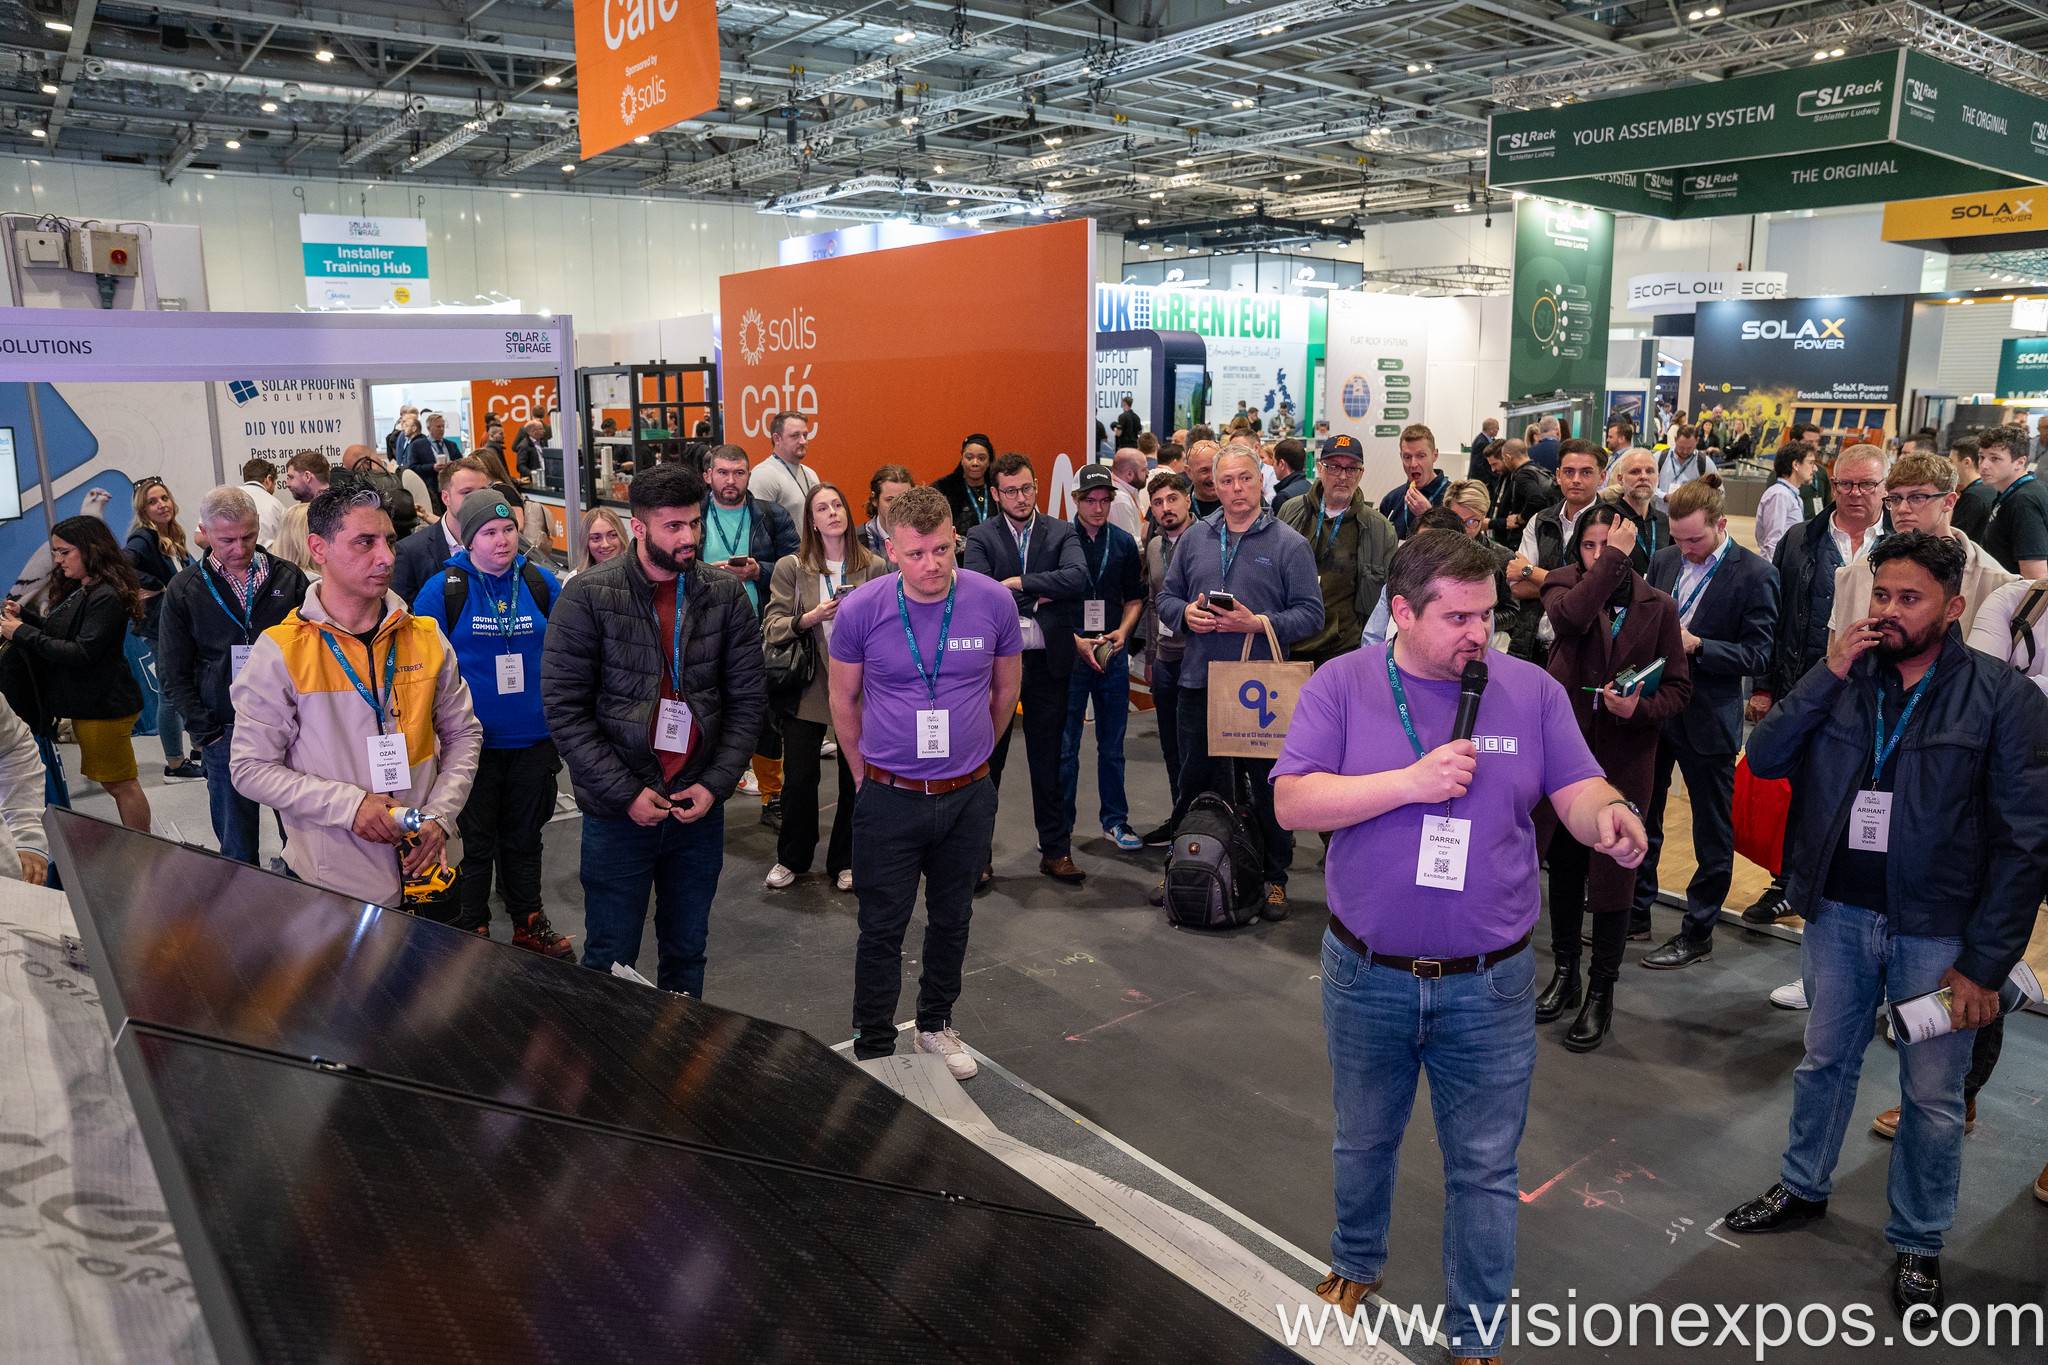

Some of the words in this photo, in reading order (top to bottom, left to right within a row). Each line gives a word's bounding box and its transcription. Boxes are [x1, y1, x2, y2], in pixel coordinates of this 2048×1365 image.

[638, 75, 666, 111] solis
[1816, 86, 1844, 108] SL
[1844, 79, 1884, 98] Rack
[1912, 80, 1924, 102] SL
[1923, 84, 1938, 100] Rack
[1813, 111, 1849, 123] Schletter
[1850, 106, 1880, 118] Ludwig
[1962, 105, 1976, 126] THE
[1976, 111, 2008, 136] ORGINIAL
[1572, 127, 1615, 146] YOUR
[1618, 113, 1703, 141] ASSEMBLY
[1705, 103, 1776, 130] SYSTEM
[1510, 132, 1530, 149] SL
[1529, 128, 1556, 142] Rack
[1509, 152, 1534, 162] Schletter
[1534, 150, 1555, 160] Ludwig
[1791, 168, 1820, 185] THE
[1823, 160, 1899, 182] ORGINIAL
[1608, 173, 1637, 188] SYSTEM
[1650, 174, 1661, 188] SL
[1660, 176, 1674, 187] Rack
[1695, 175, 1714, 189] SL
[1713, 172, 1738, 184] Rack
[1717, 190, 1737, 199] Ludwig
[1951, 198, 2033, 220] SOLAX
[1992, 214, 2032, 224] POWER
[349, 229, 381, 237] STORAGE
[337, 246, 394, 260] Installer
[323, 260, 380, 276] Training
[383, 262, 411, 274] Hub
[1634, 281, 1723, 299] ECOFLOW
[1098, 287, 1132, 332] UK
[1152, 293, 1281, 340] GREENTECH
[768, 305, 817, 352] solis
[1741, 318, 1846, 340] SOLAX
[505, 332, 539, 343] SOLAR
[540, 332, 548, 343] &
[1793, 338, 1845, 350] POWER
[505, 343, 552, 353] STORAGE
[1097, 350, 1129, 364] UPPLY
[262, 379, 298, 392] SOLAR
[301, 378, 355, 391] PROOFING
[1096, 368, 1139, 387] UPPORT
[1832, 383, 1856, 393] SolaX
[1857, 383, 1889, 393] Powers
[1833, 391, 1858, 400] Green
[1859, 391, 1888, 400] Future
[262, 392, 356, 402] SOLUTIONS
[741, 363, 819, 441] café
[245, 421, 266, 436] DID
[271, 420, 295, 435] YOU
[300, 419, 342, 433] KNOW?
[251, 447, 277, 459] Pests
[279, 449, 294, 458] are
[326, 444, 341, 456] the
[472, 615, 493, 623] SOUTH
[950, 638, 983, 649] CEF
[1399, 703, 1415, 737] GivEnergy
[1857, 807, 1886, 815] ARIHANT
[1429, 835, 1460, 845] DARREN
[1423, 872, 1446, 880] Exhibitor
[1238, 1289, 1251, 1301] 20
